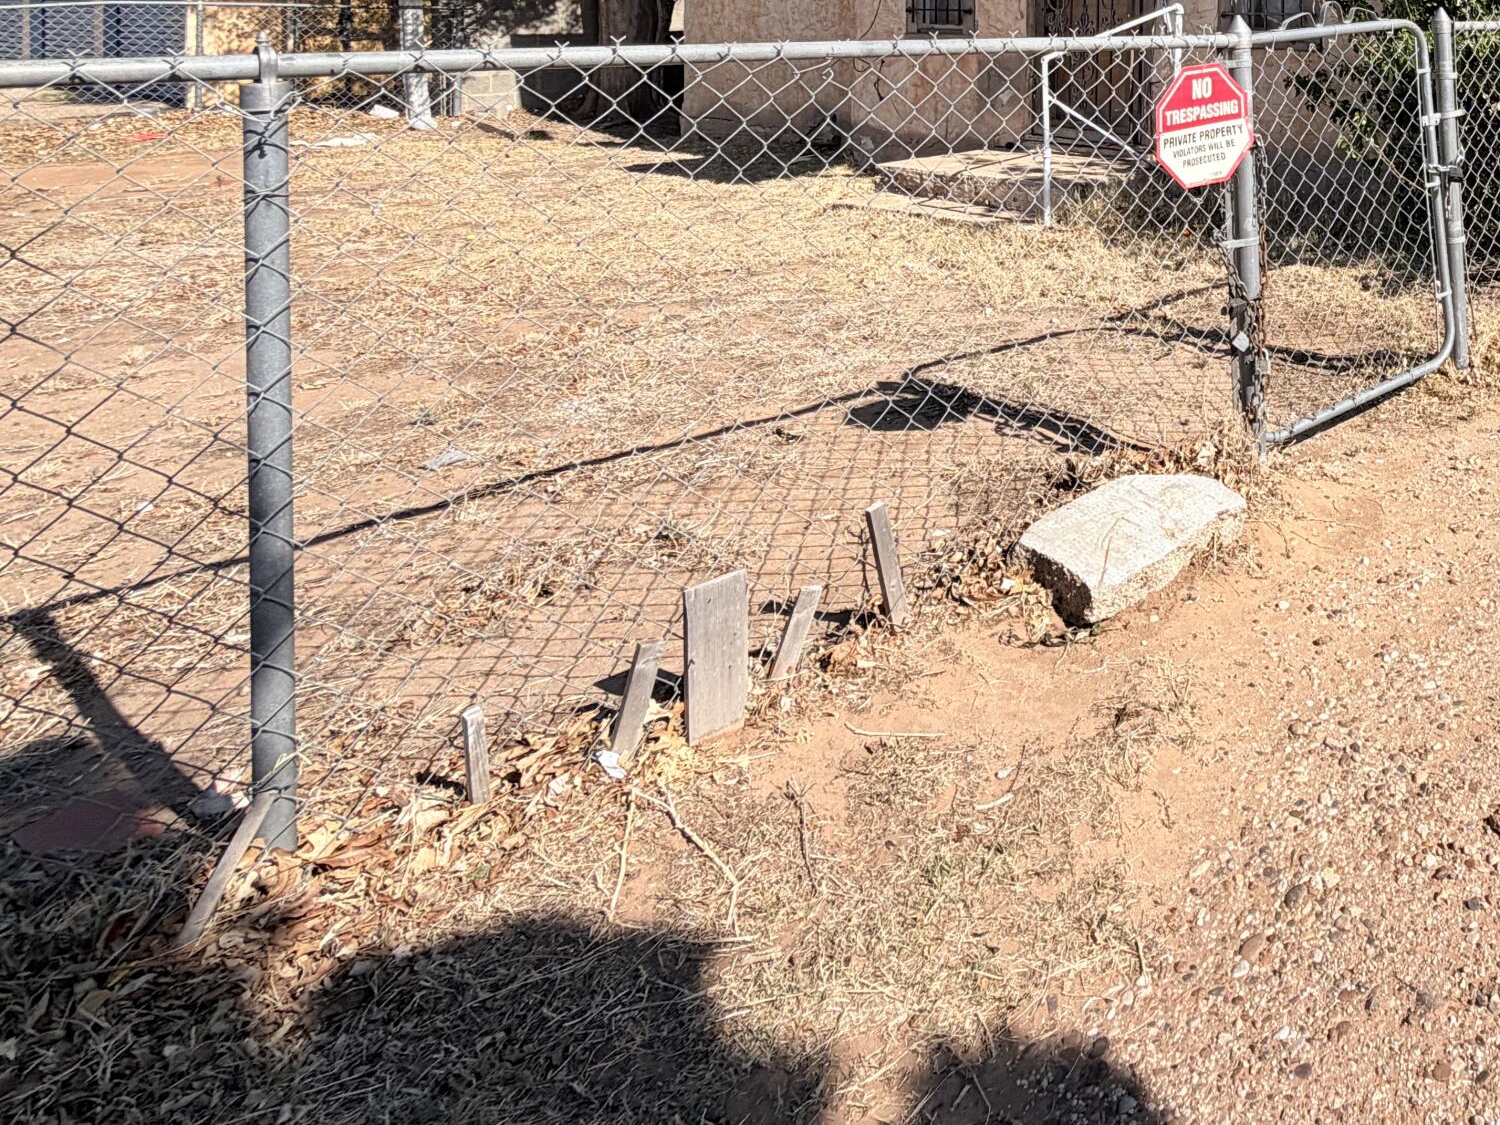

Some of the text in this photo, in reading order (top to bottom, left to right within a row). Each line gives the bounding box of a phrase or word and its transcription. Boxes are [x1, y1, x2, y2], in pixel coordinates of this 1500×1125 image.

[1192, 77, 1212, 100] NO
[1165, 99, 1239, 126] TRESPASSING
[1163, 125, 1243, 149] PRIVATE PROPERTY
[1173, 138, 1236, 158] VIOLATORS WILL BE
[1182, 152, 1226, 168] PROSECUTED
